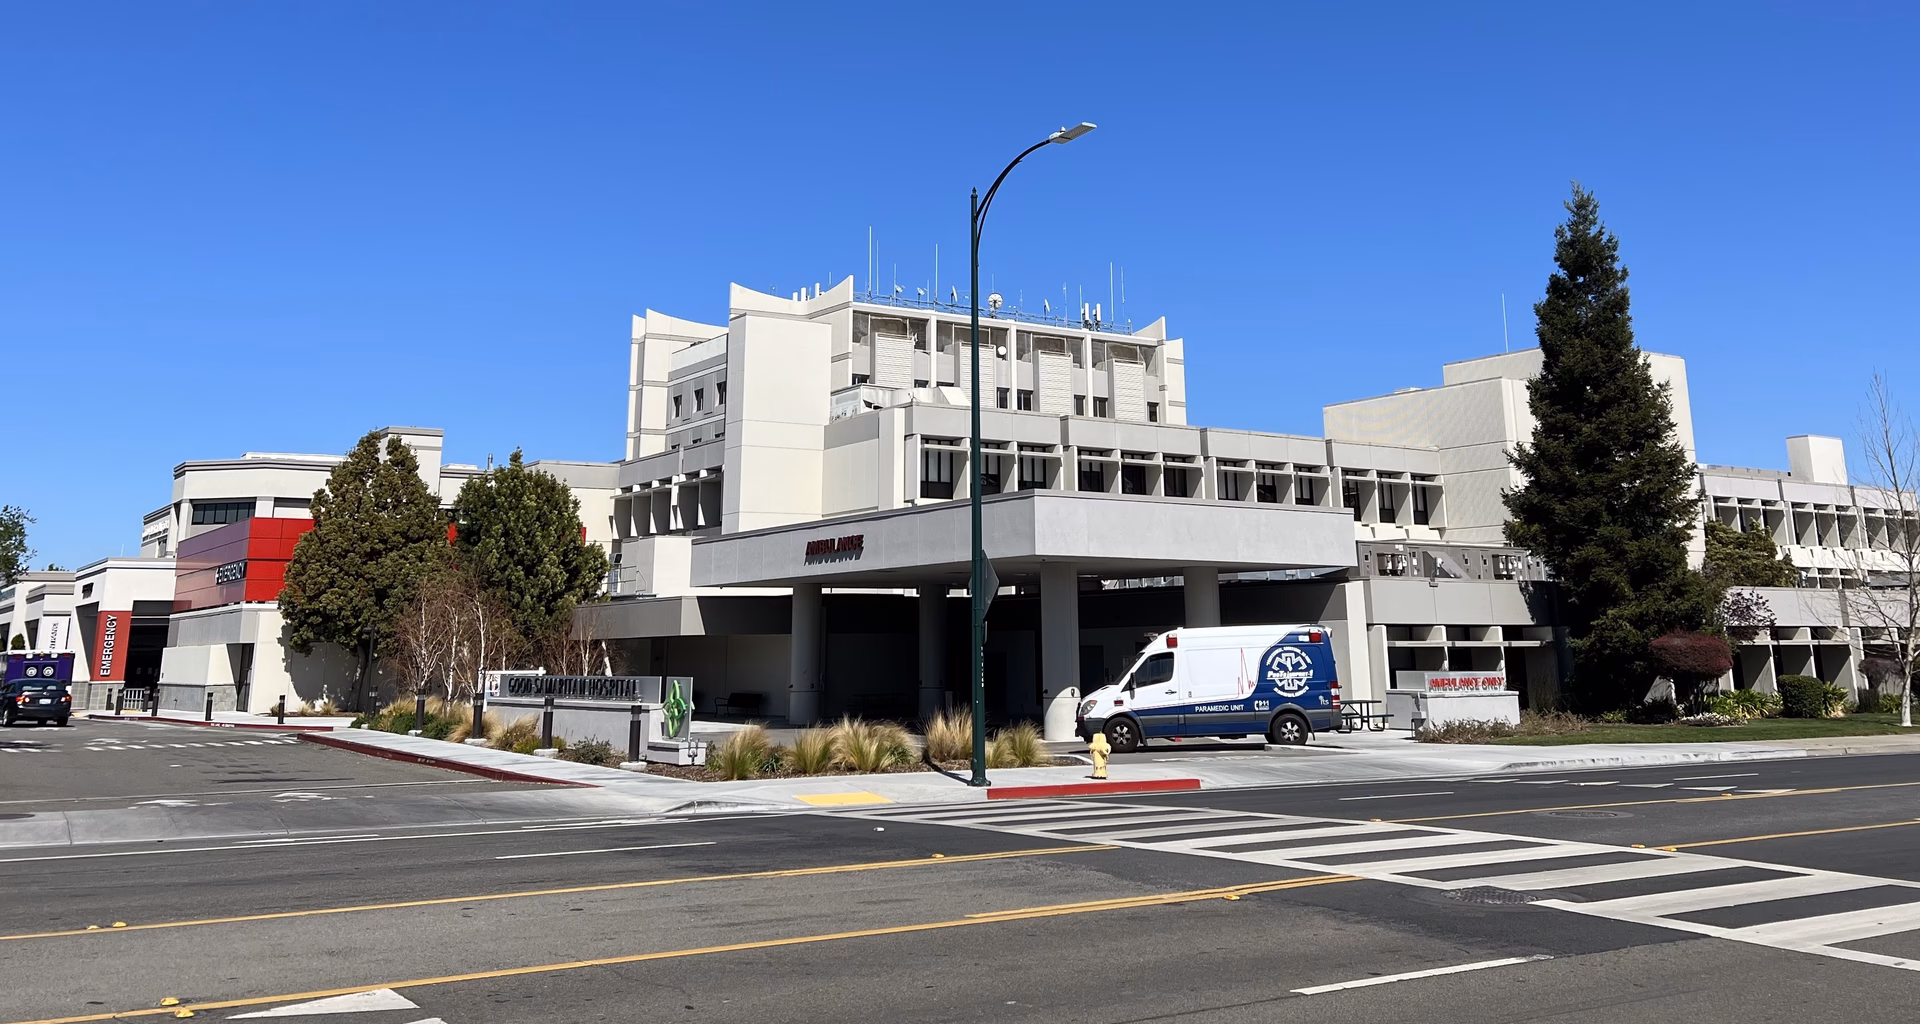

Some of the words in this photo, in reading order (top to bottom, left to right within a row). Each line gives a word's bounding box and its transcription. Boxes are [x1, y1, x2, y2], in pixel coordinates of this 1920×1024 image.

[805, 534, 864, 556] AMBULANCE
[100, 614, 118, 676] EMERGENCY
[508, 678, 532, 694] GOOD
[534, 678, 586, 695] SAMARITAN
[588, 679, 637, 696] HOSPITAL
[1429, 676, 1480, 688] AMBULANCE
[1482, 676, 1505, 687] ONLY
[1195, 704, 1229, 712] PARAMEDIC
